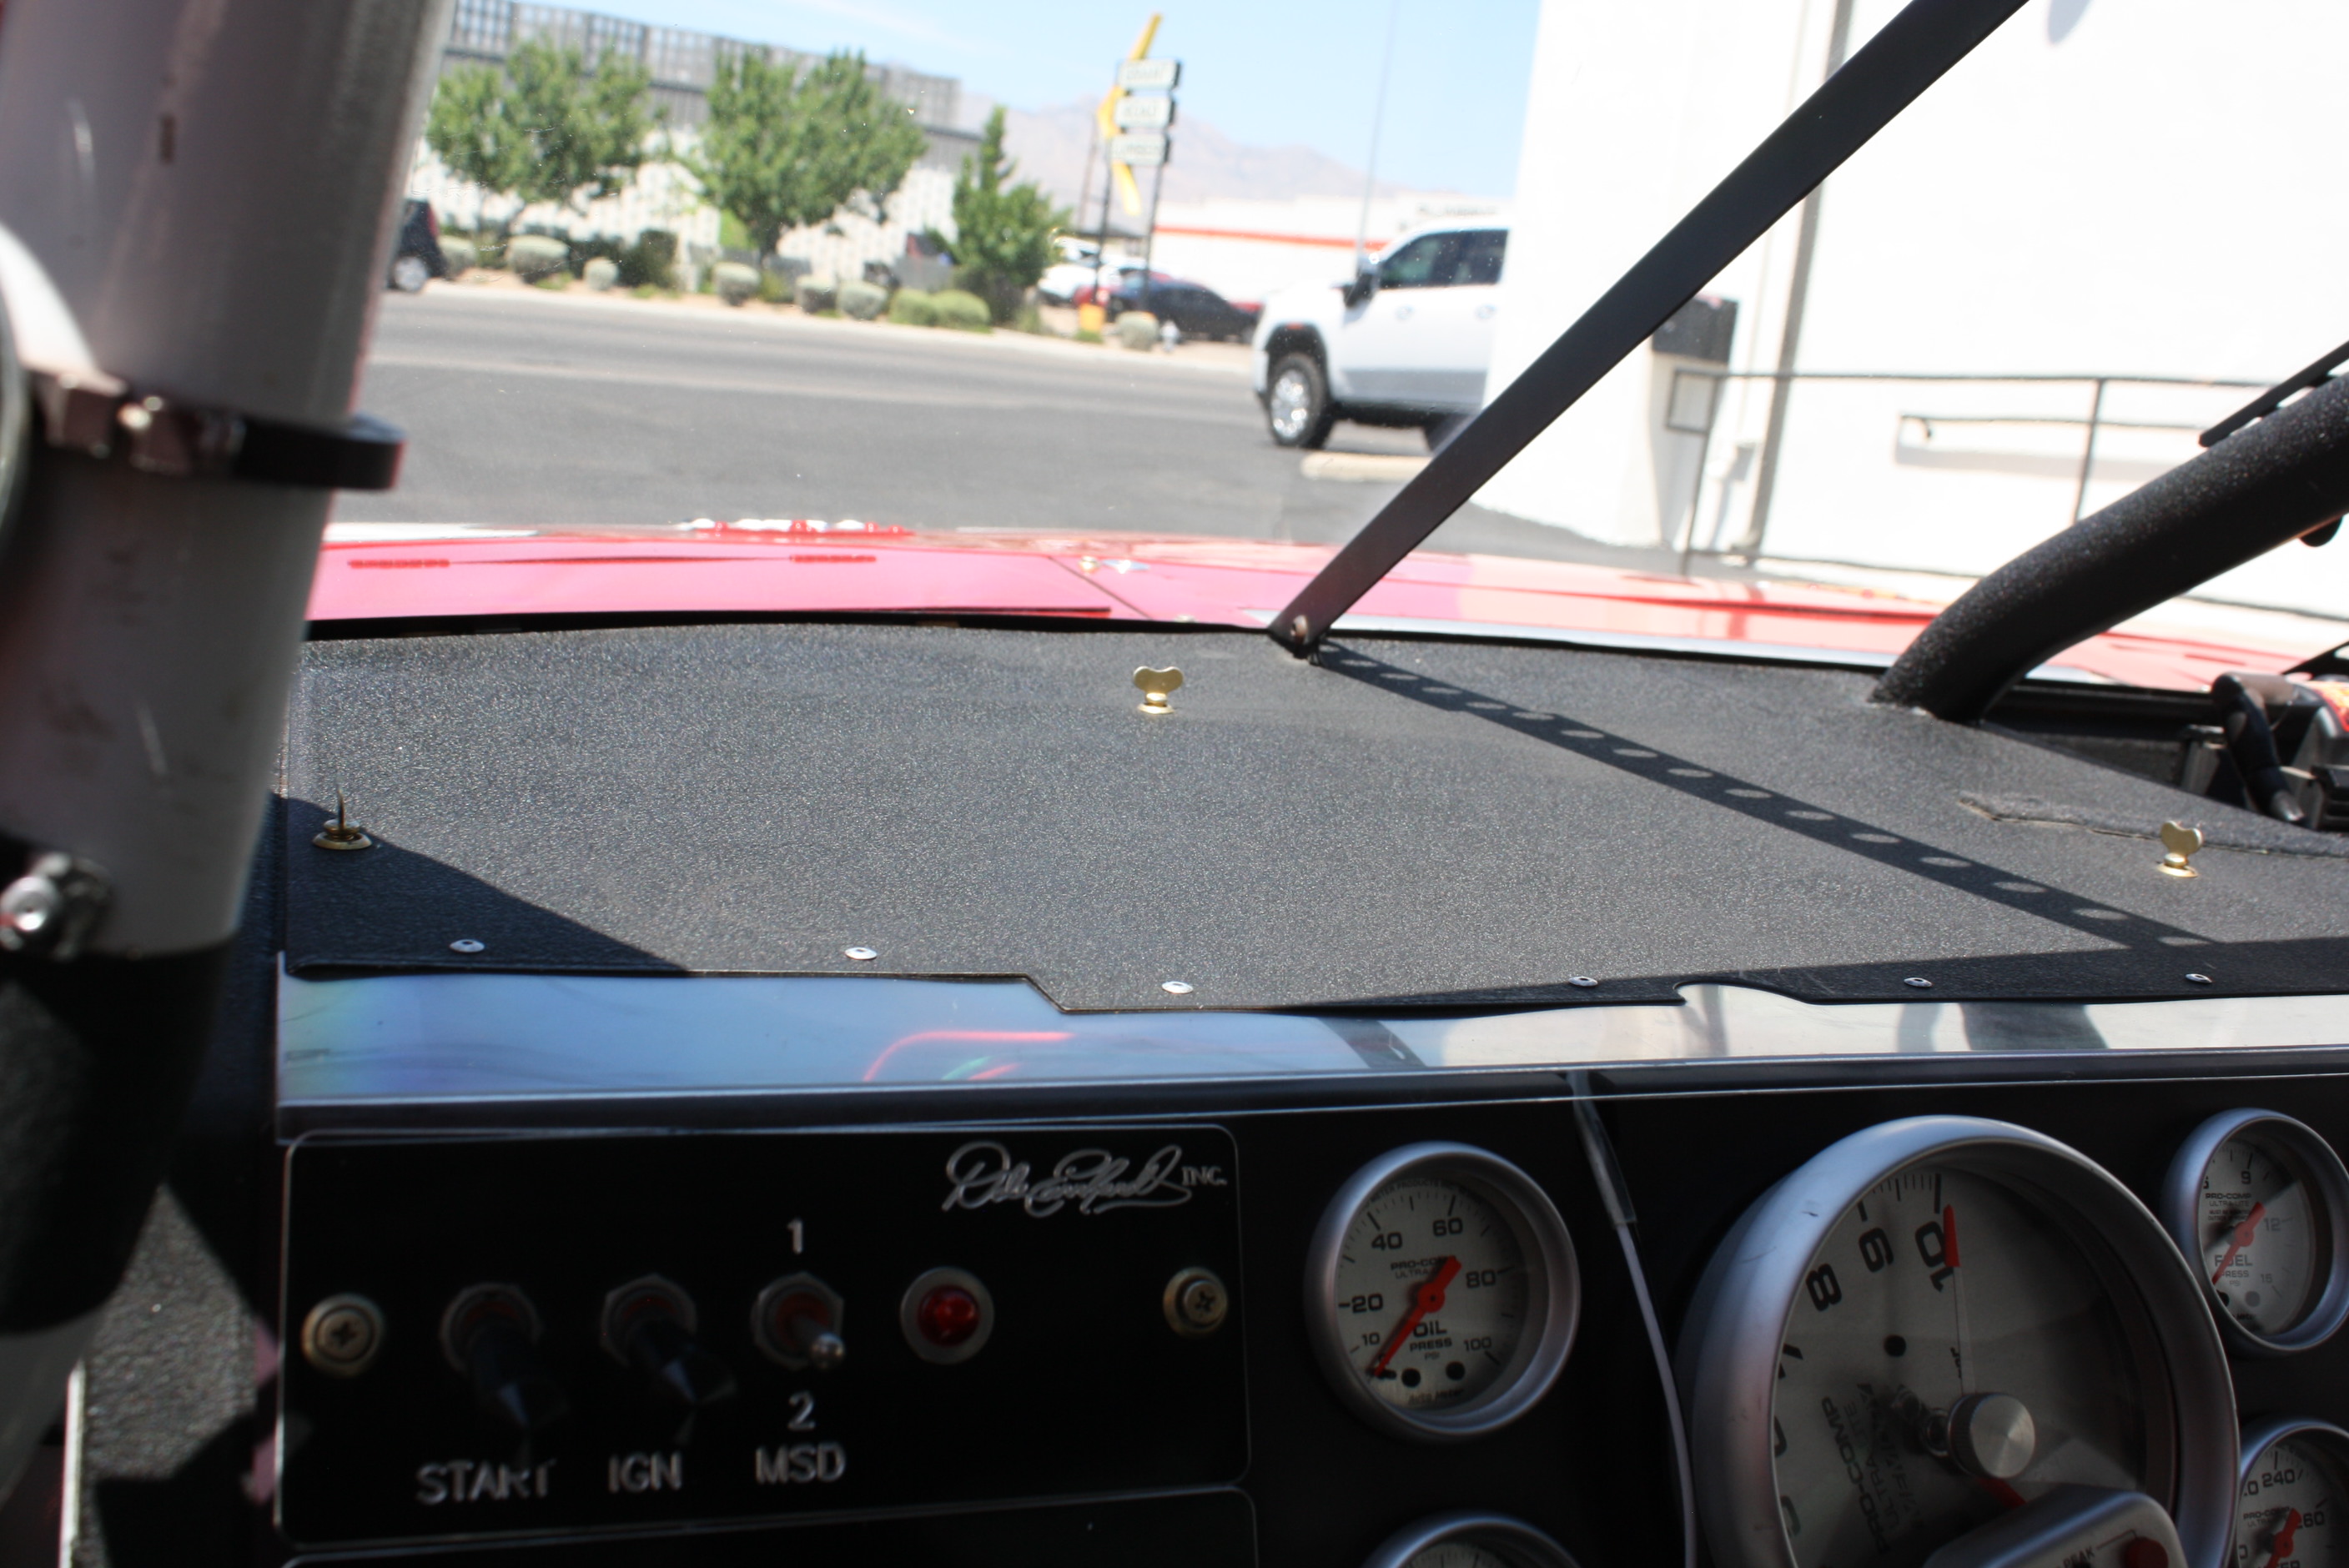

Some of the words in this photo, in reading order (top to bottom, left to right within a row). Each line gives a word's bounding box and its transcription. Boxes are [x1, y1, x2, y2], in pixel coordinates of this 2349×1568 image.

[2241, 1170, 2252, 1185] 9
[1432, 1217, 1463, 1237] 60
[2263, 1218, 2281, 1232] 12
[787, 1218, 803, 1254] 1
[1371, 1232, 1403, 1250] 40
[1466, 1269, 1496, 1289] 80
[1805, 1262, 1843, 1312] 8
[2260, 1273, 2274, 1284] 15
[1361, 1332, 1381, 1346] 10
[1412, 1320, 1447, 1339] OIL
[1409, 1338, 1452, 1352] PRESS
[1463, 1336, 1492, 1352] 100
[1424, 1351, 1441, 1361] PSI
[787, 1390, 816, 1430] 2
[608, 1452, 682, 1493] IGN
[755, 1442, 846, 1484] MSD
[416, 1458, 556, 1504] START
[1822, 1396, 1891, 1555] PRO-COMP
[2261, 1469, 2295, 1488] 240
